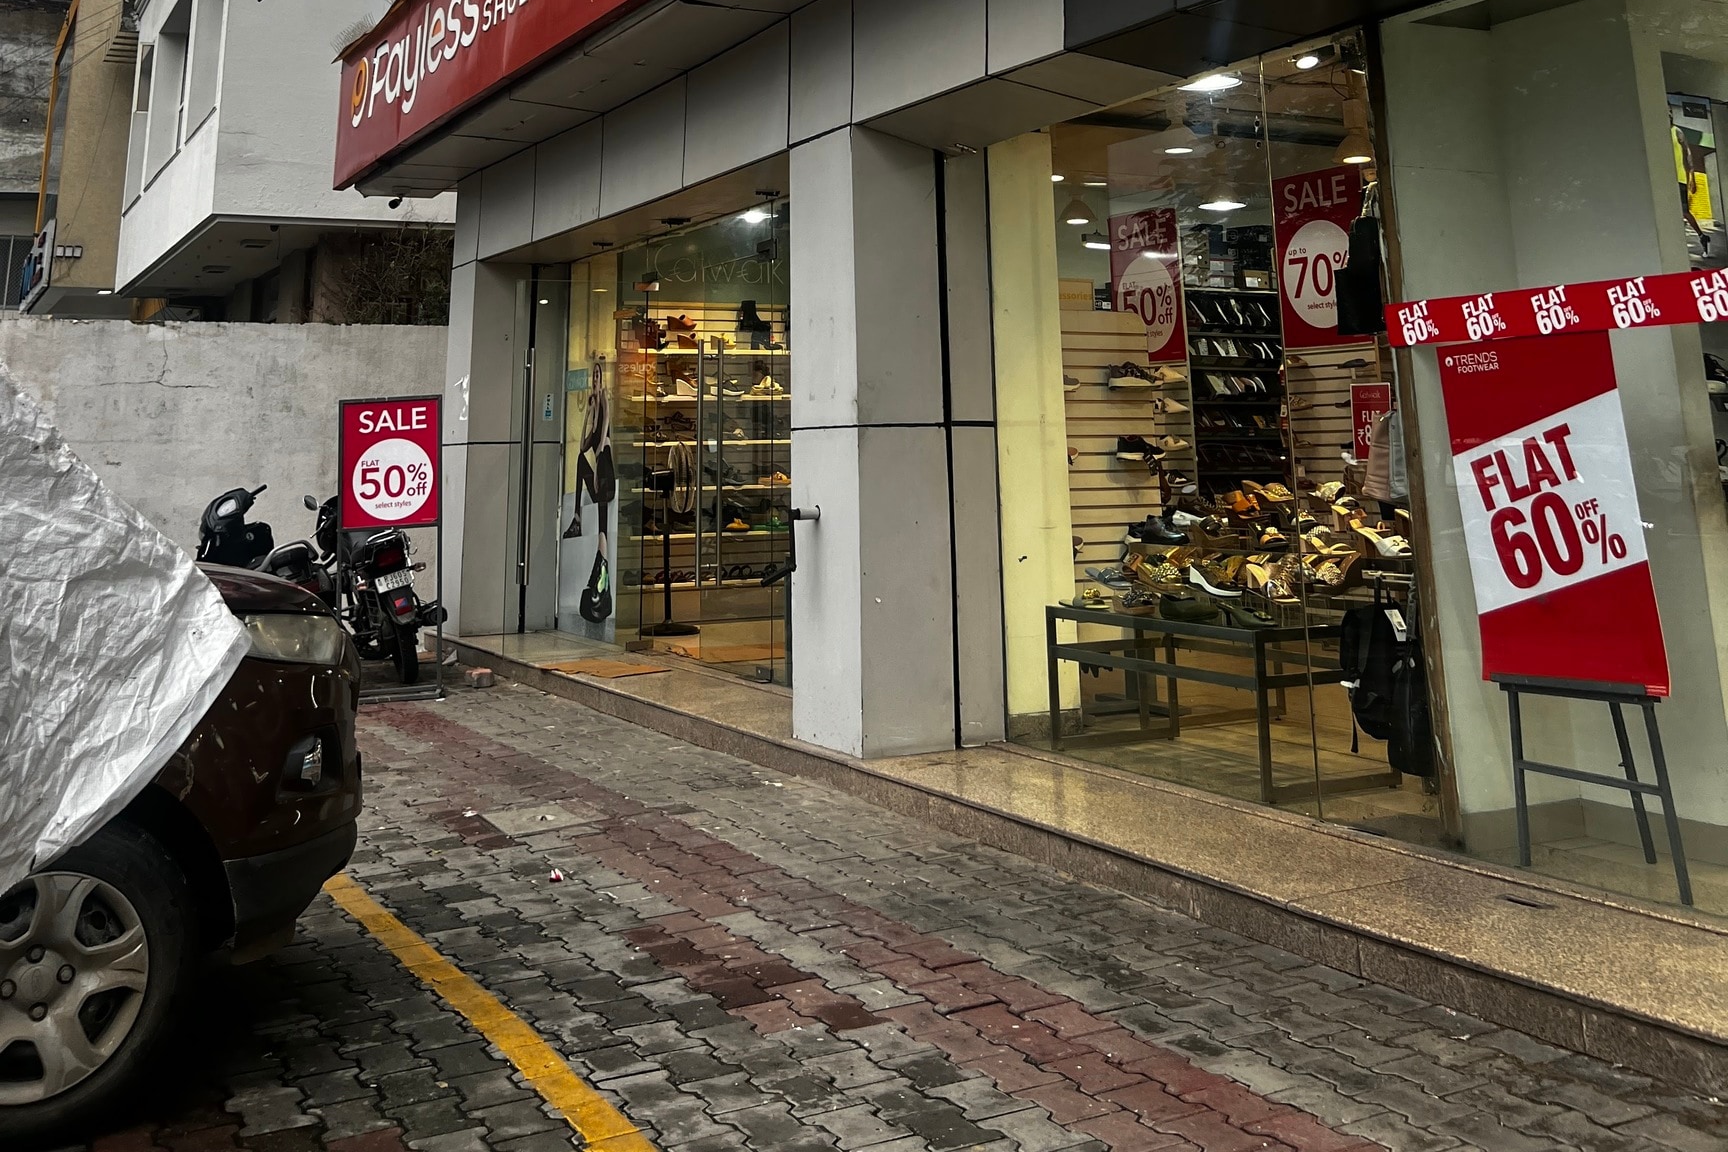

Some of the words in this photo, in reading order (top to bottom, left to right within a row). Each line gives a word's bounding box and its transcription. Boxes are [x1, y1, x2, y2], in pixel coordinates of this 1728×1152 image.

[1284, 174, 1347, 213] SALE
[1117, 217, 1168, 251] SALE
[1530, 285, 1566, 313] FLAT
[1606, 276, 1646, 305] FLAT
[1158, 307, 1173, 325] off
[1307, 301, 1324, 310] select
[1325, 299, 1337, 310] styl
[1398, 300, 1429, 326] FLAT
[1461, 293, 1495, 319] FLAT
[1612, 297, 1661, 329] 60%
[1402, 318, 1439, 346] 60%
[1466, 312, 1506, 341] 60%
[1536, 304, 1580, 335] 60%
[1453, 351, 1498, 366] TRENDS
[1457, 362, 1499, 374] FOOTWEAR
[359, 407, 427, 434] SALE
[1362, 410, 1380, 423] FL
[361, 460, 379, 468] FLAT
[1470, 422, 1577, 512] FLAT
[406, 481, 427, 496] off
[375, 501, 393, 509] select
[394, 499, 412, 509] styles
[1490, 491, 1627, 590] 60%
[1574, 498, 1600, 520] OFF
